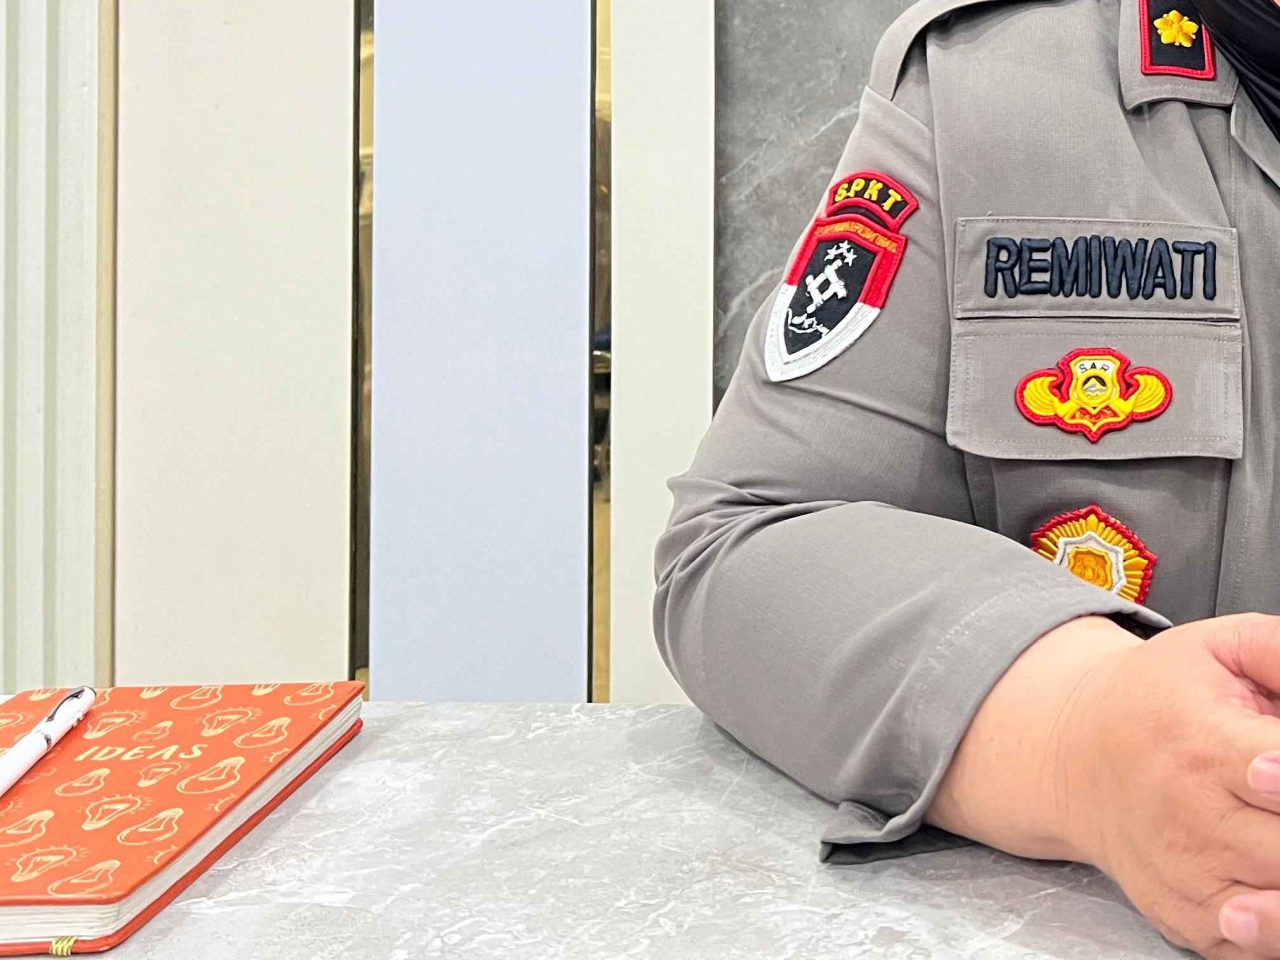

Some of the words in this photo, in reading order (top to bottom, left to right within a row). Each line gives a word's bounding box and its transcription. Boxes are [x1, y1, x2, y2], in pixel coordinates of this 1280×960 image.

[834, 178, 904, 211] SPKT
[984, 235, 1216, 300] REMIWATI
[75, 744, 207, 761] IDEAS
